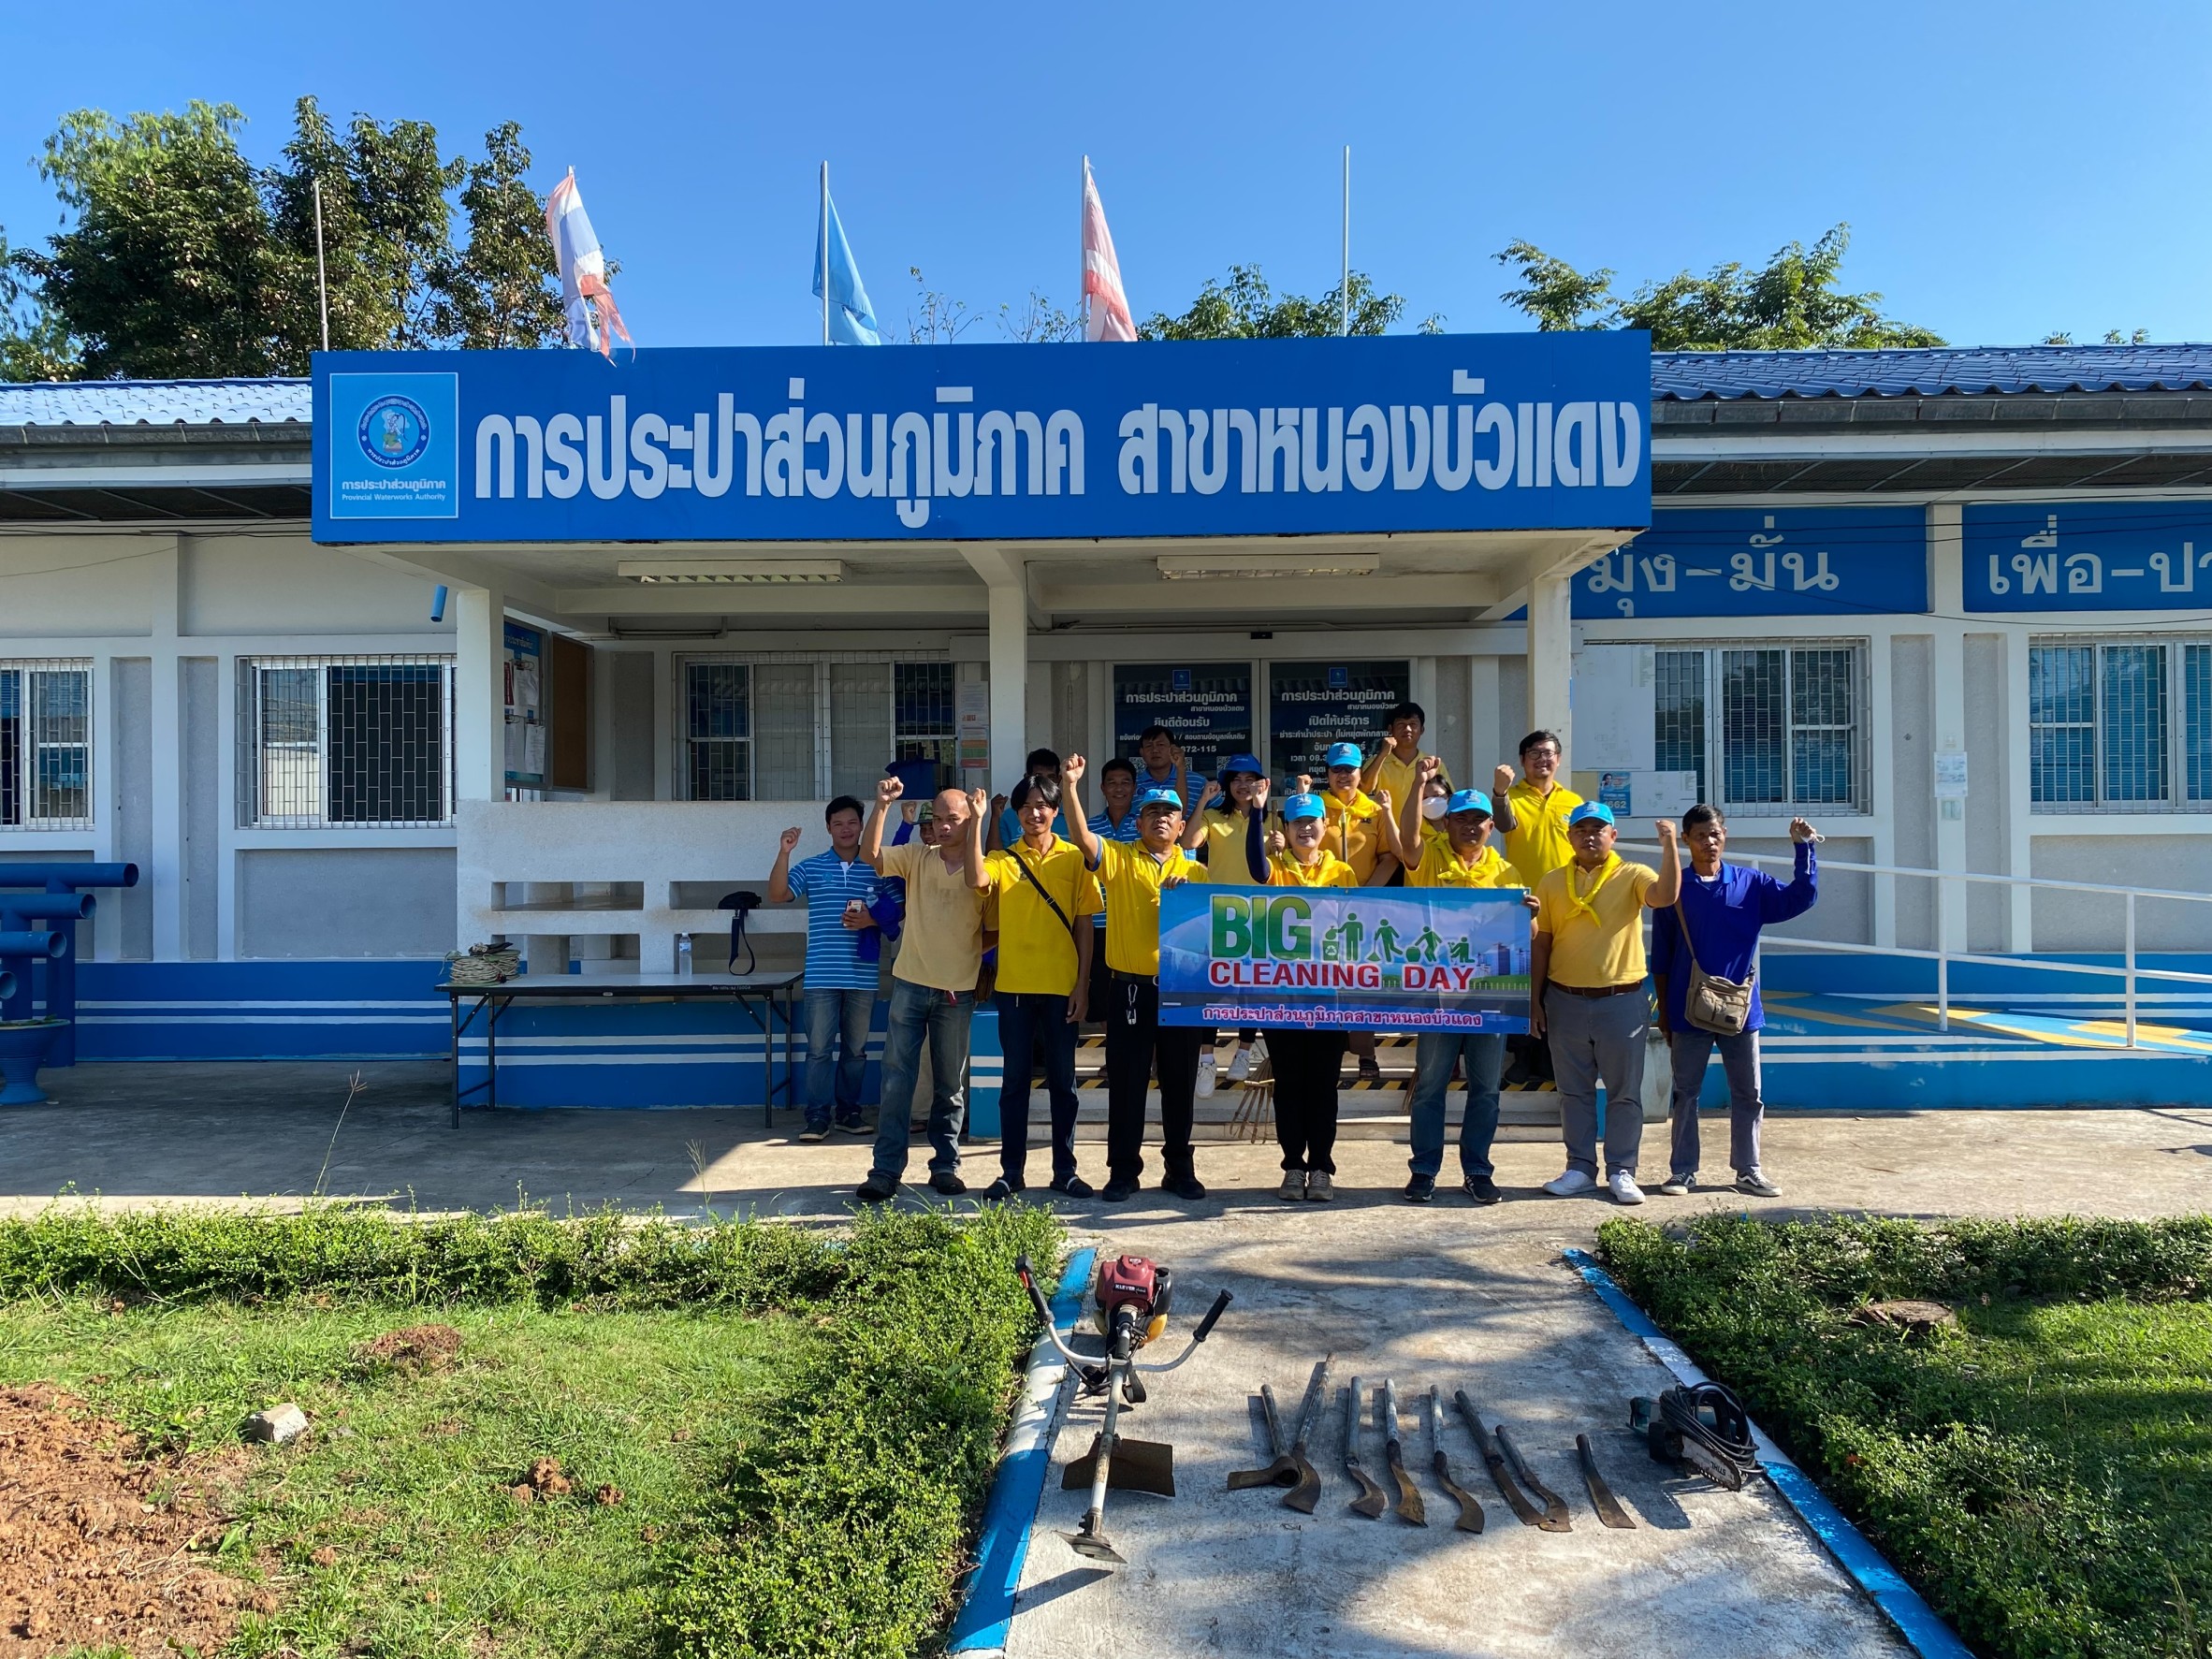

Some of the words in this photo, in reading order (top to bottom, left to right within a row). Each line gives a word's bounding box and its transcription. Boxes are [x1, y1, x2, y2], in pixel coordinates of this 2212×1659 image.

[475, 377, 1084, 529] การประปาส่วนภูมิภาค
[1118, 370, 1641, 496] สาขาหนองบัวแดง
[342, 478, 446, 492] การประปาส่วนภูมิภาค
[342, 493, 372, 502] Provincial
[374, 493, 414, 502] Waterworks
[415, 493, 446, 502] Authority
[1126, 691, 1238, 705] การประปาส่วนภูมิภาค
[1281, 689, 1395, 704] การประปาส่วนภูมิภาค
[1154, 717, 1210, 727] ยินดีต้อนรับ
[1308, 713, 1370, 726] เปิดให้บริการ
[1212, 895, 1312, 960] BIG
[1210, 961, 1380, 988] CLEANING
[1404, 966, 1475, 990] DAY
[1202, 1005, 1482, 1027] การประปาส่วนภูมิภาคสาขาหนองบัวแดง
